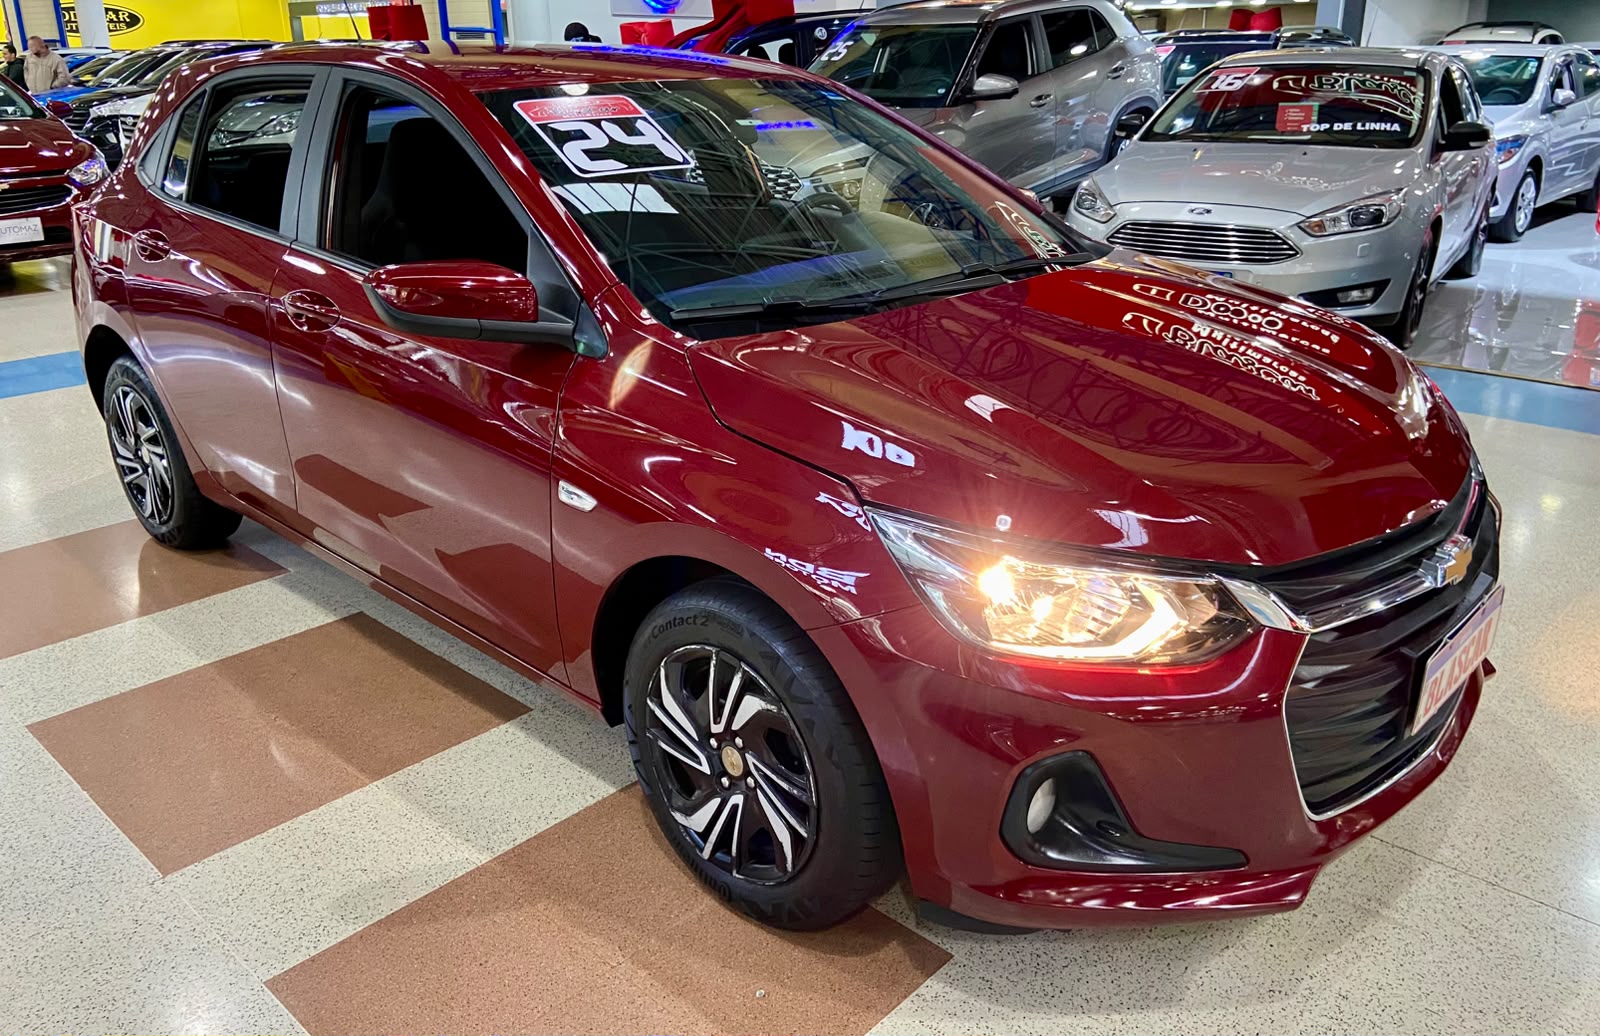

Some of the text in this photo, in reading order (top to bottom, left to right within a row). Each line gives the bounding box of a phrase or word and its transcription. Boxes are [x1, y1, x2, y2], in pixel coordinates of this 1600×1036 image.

[820, 41, 854, 61] 25
[1211, 74, 1245, 89] 16
[1301, 121, 1400, 132] TOP DE LINHA
[547, 119, 683, 172] 24
[0, 223, 39, 235] UTOMAZ
[650, 613, 698, 641] Contact
[699, 614, 710, 627] 2
[1423, 617, 1494, 718] BLASCAR
